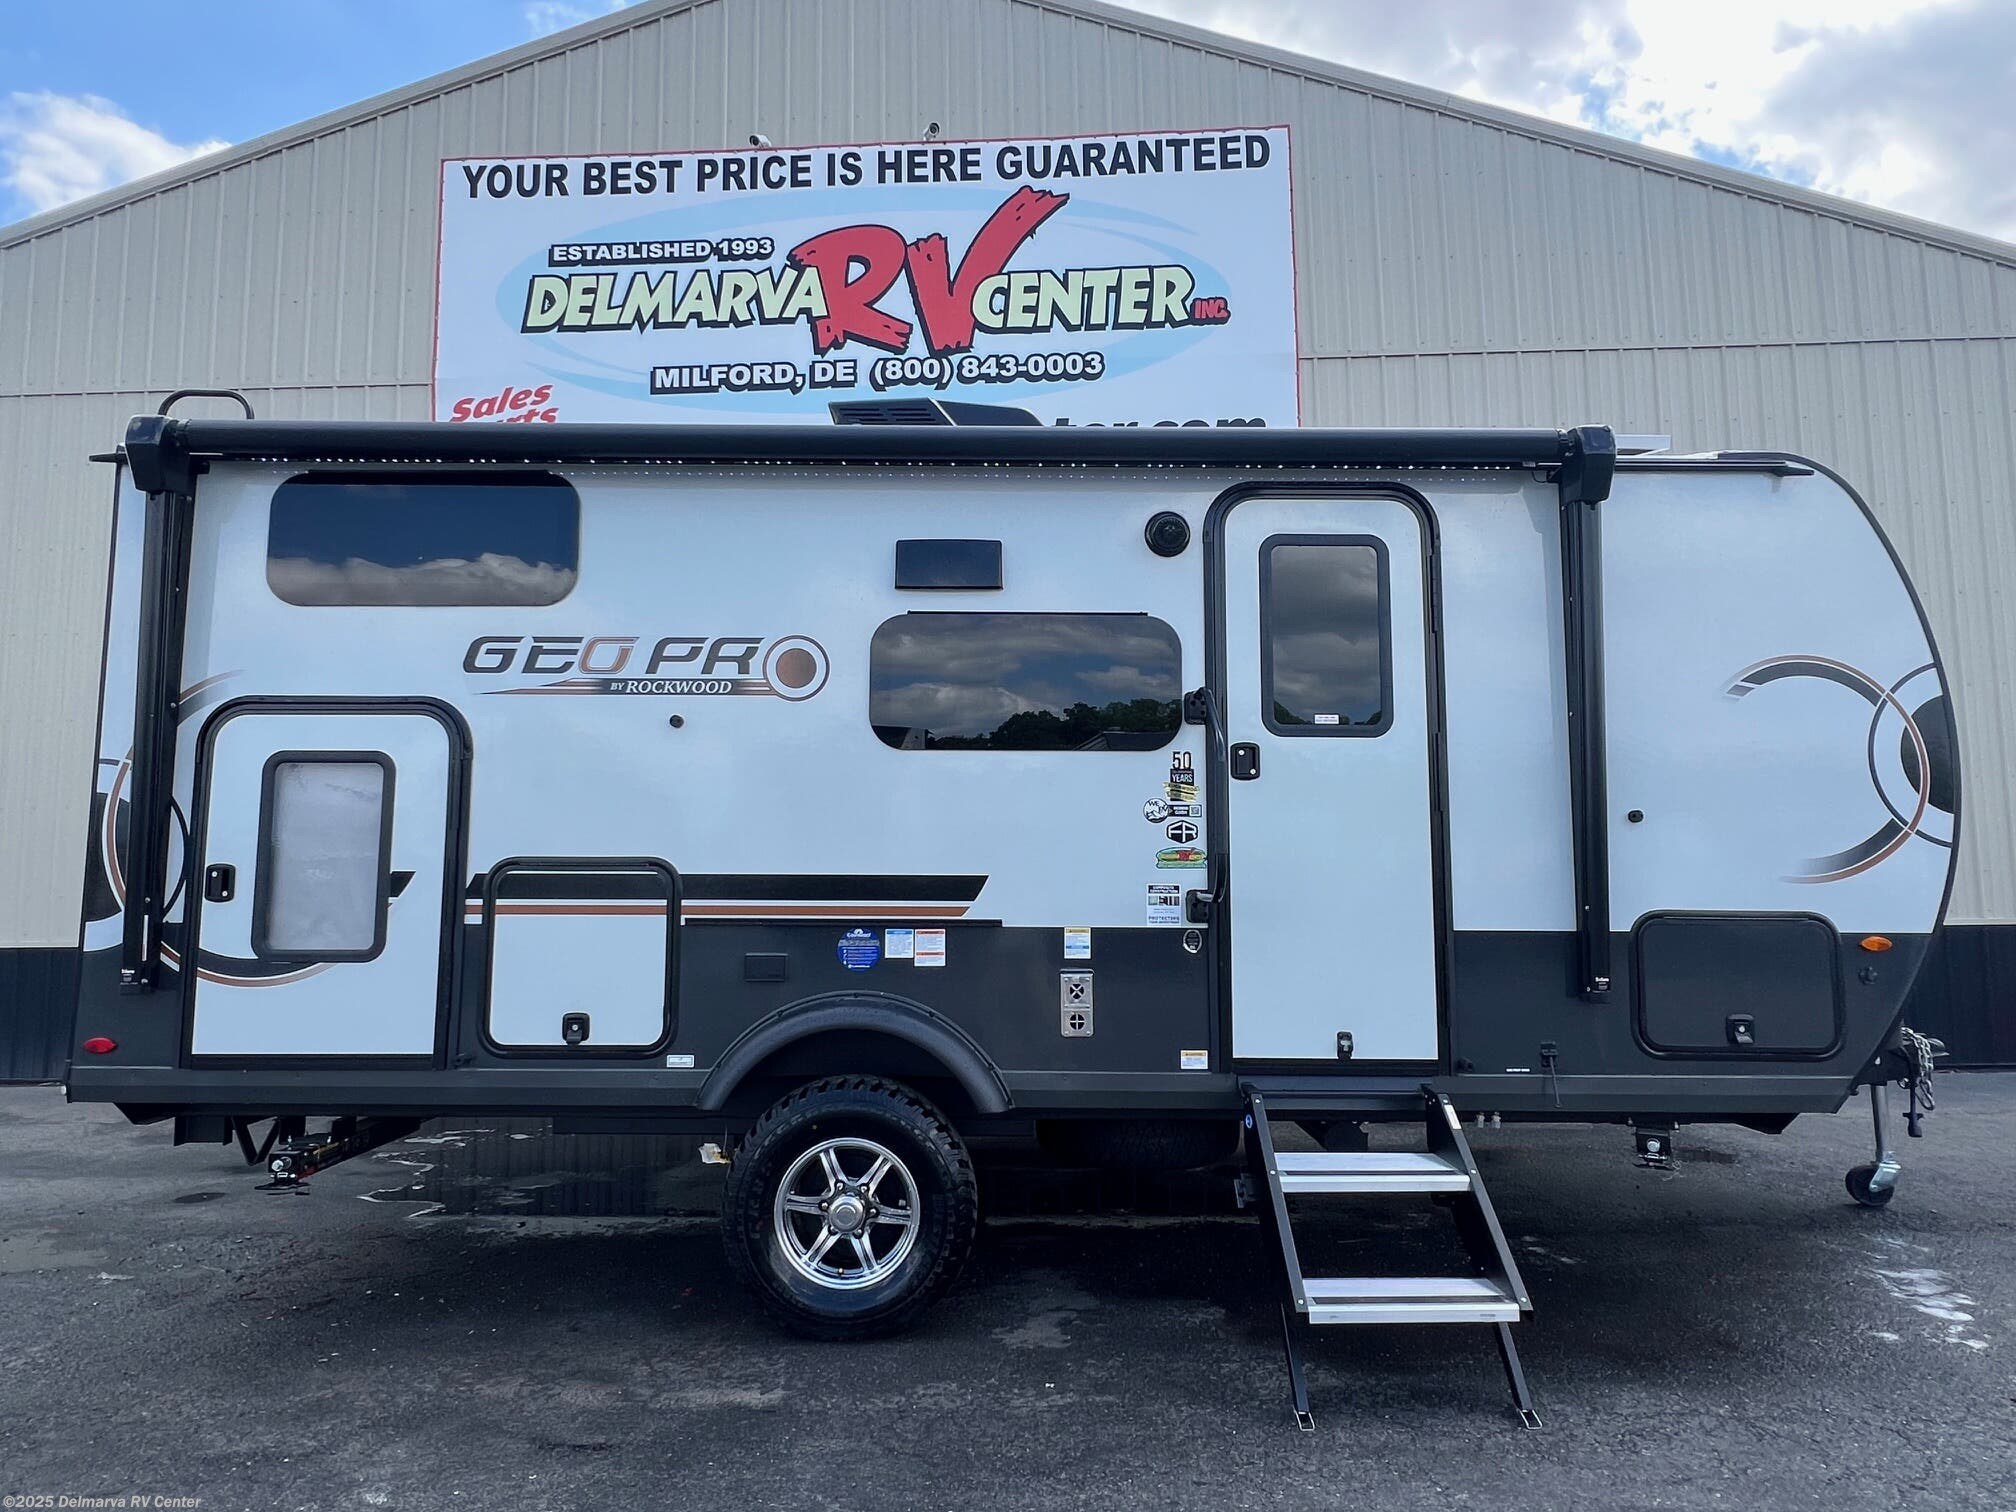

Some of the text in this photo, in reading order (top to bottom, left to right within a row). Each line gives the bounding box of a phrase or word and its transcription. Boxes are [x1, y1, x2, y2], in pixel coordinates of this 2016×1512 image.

[463, 134, 1271, 199] YOUR BEST PRICE IS HERE GUARANTEED
[522, 266, 828, 333] DELMARVA
[787, 185, 1070, 356] RV
[972, 264, 1195, 333] CENTER
[551, 239, 774, 264] ESTABLISHED 1993
[651, 352, 1105, 395] MILFORD, DE (800) 843-0003
[450, 385, 554, 423] Sales
[462, 636, 640, 675] GEO
[610, 680, 732, 694] BY ROCKWOOD
[1172, 751, 1192, 769] 50
[1172, 773, 1193, 783] YEARS
